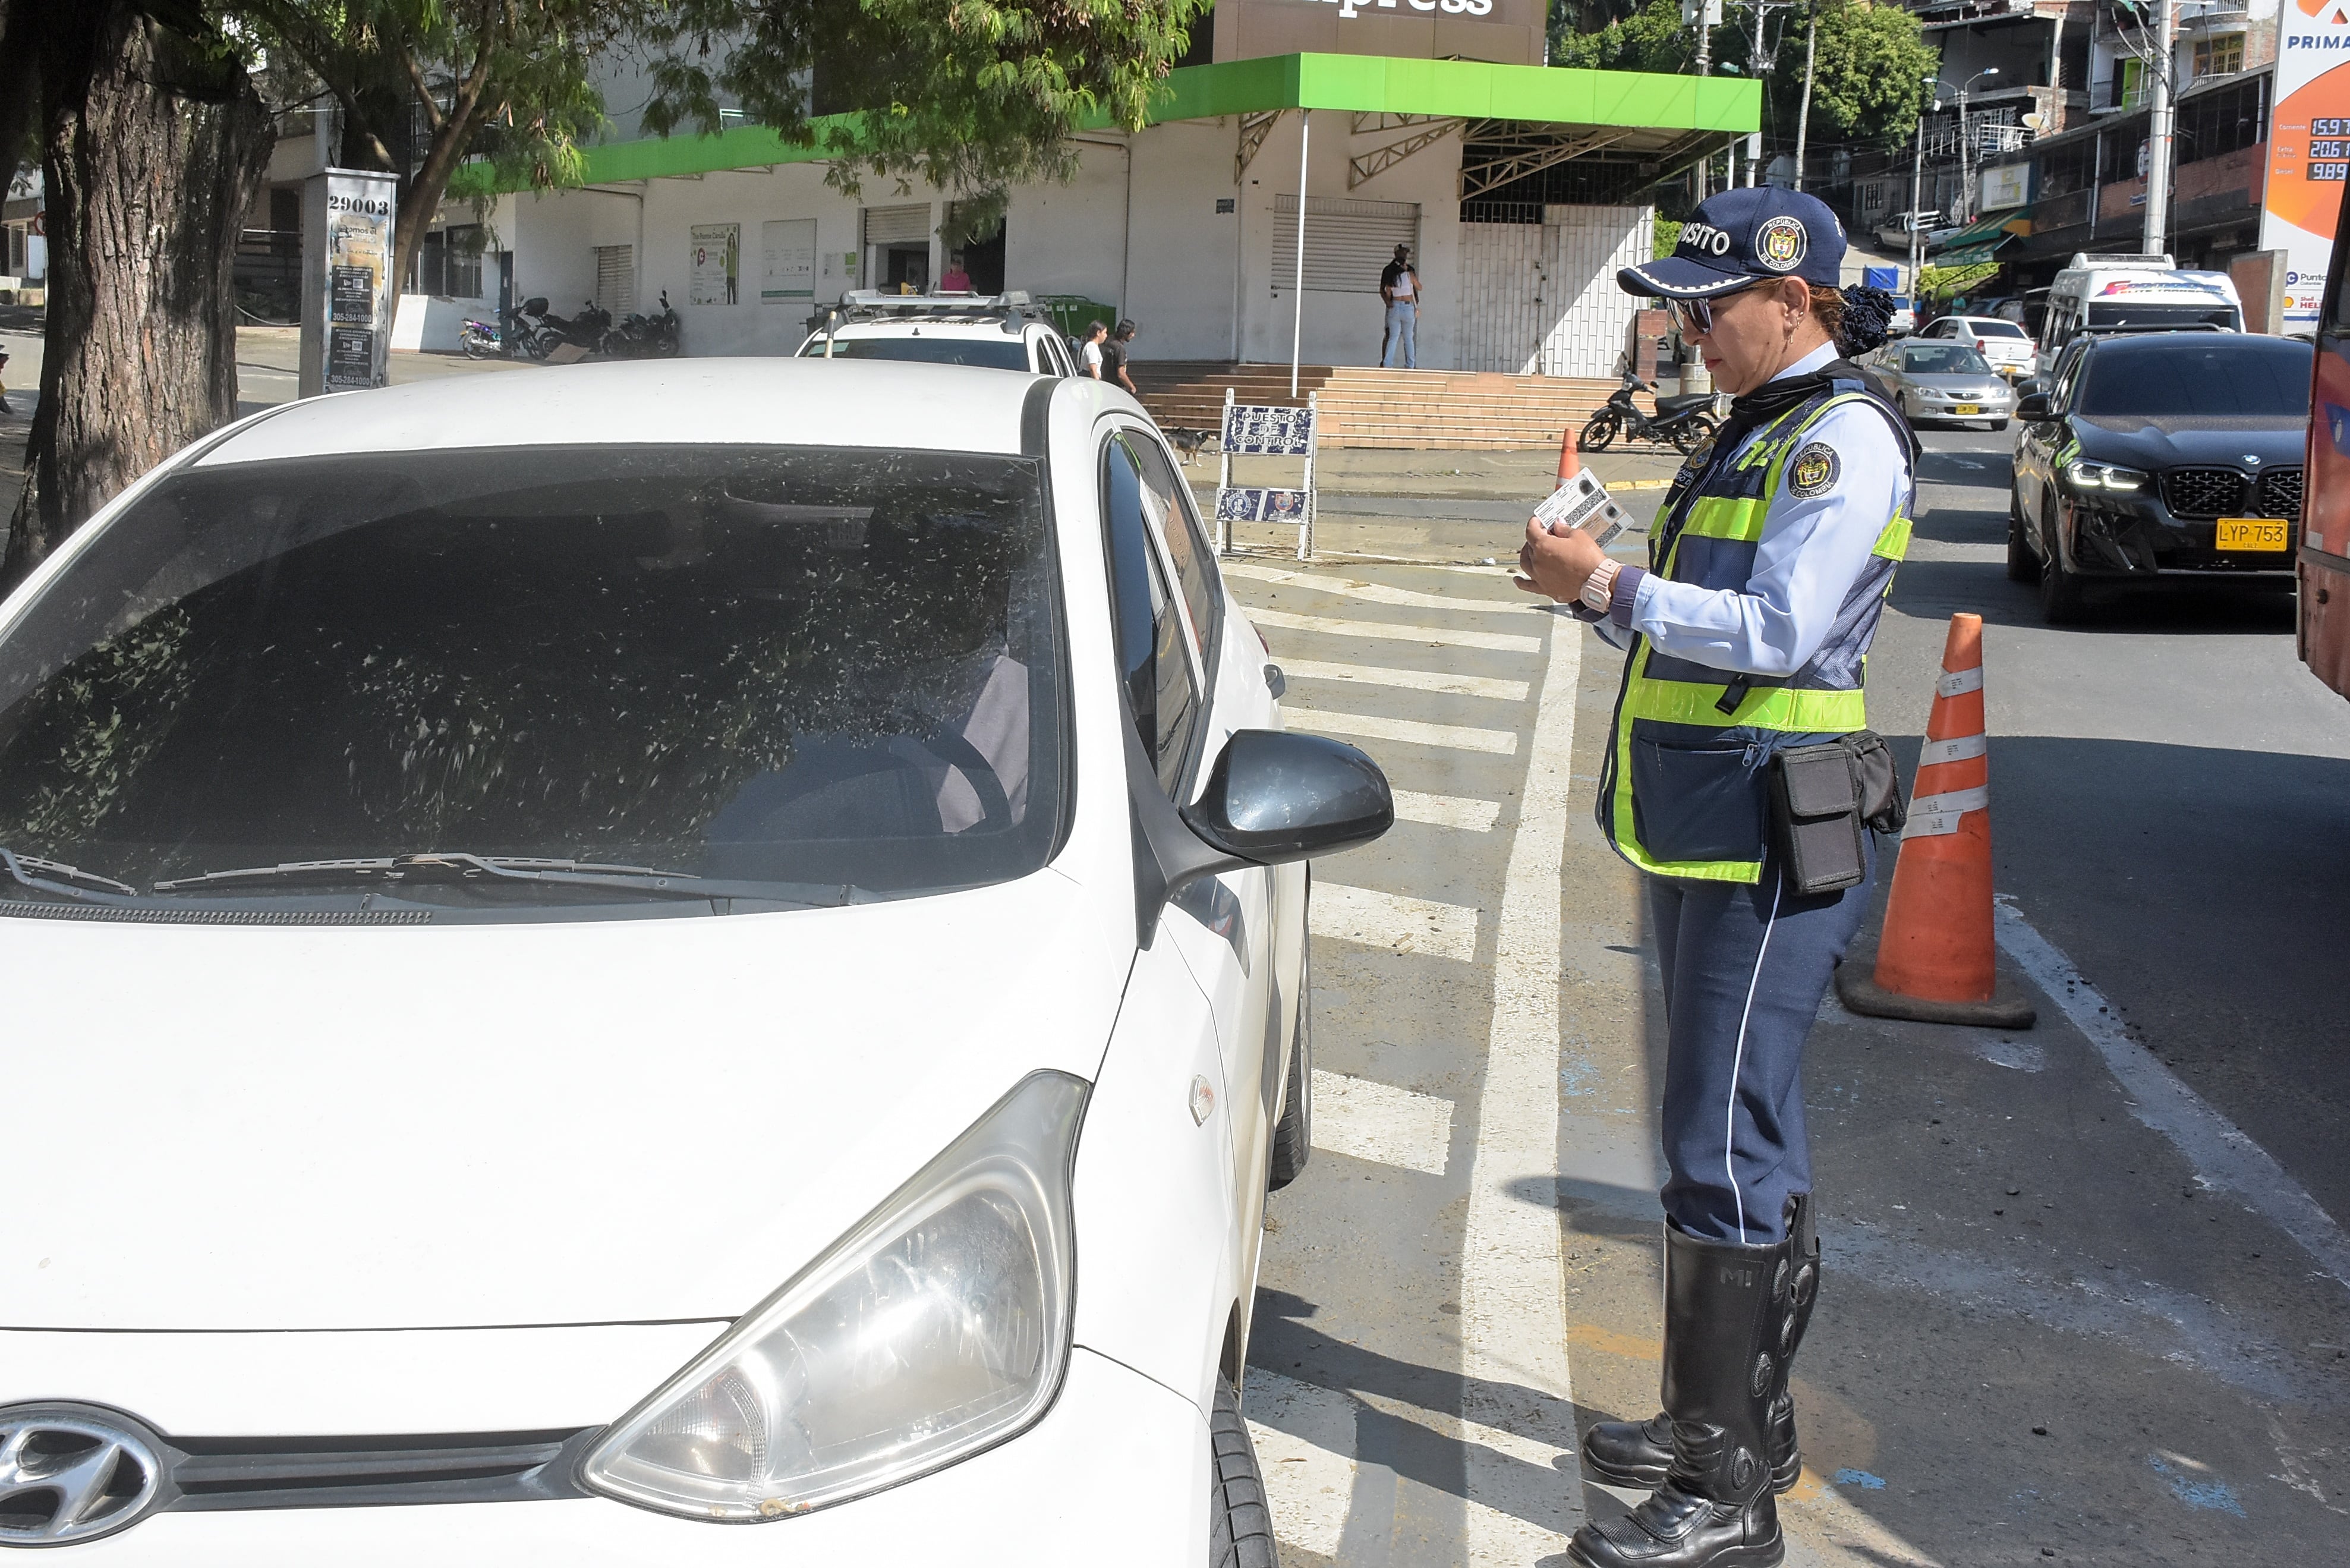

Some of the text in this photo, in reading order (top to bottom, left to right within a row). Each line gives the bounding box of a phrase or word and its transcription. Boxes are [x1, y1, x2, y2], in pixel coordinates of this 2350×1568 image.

[329, 196, 389, 215] 29003
[333, 313, 371, 322] 305-284-1000
[331, 374, 370, 386] 305-284-1000
[1242, 413, 1297, 424] PUESTO
[1236, 435, 1302, 447] CONTROL
[1795, 481, 1835, 497] COLOMBIA
[2220, 525, 2283, 542] LYP 753
